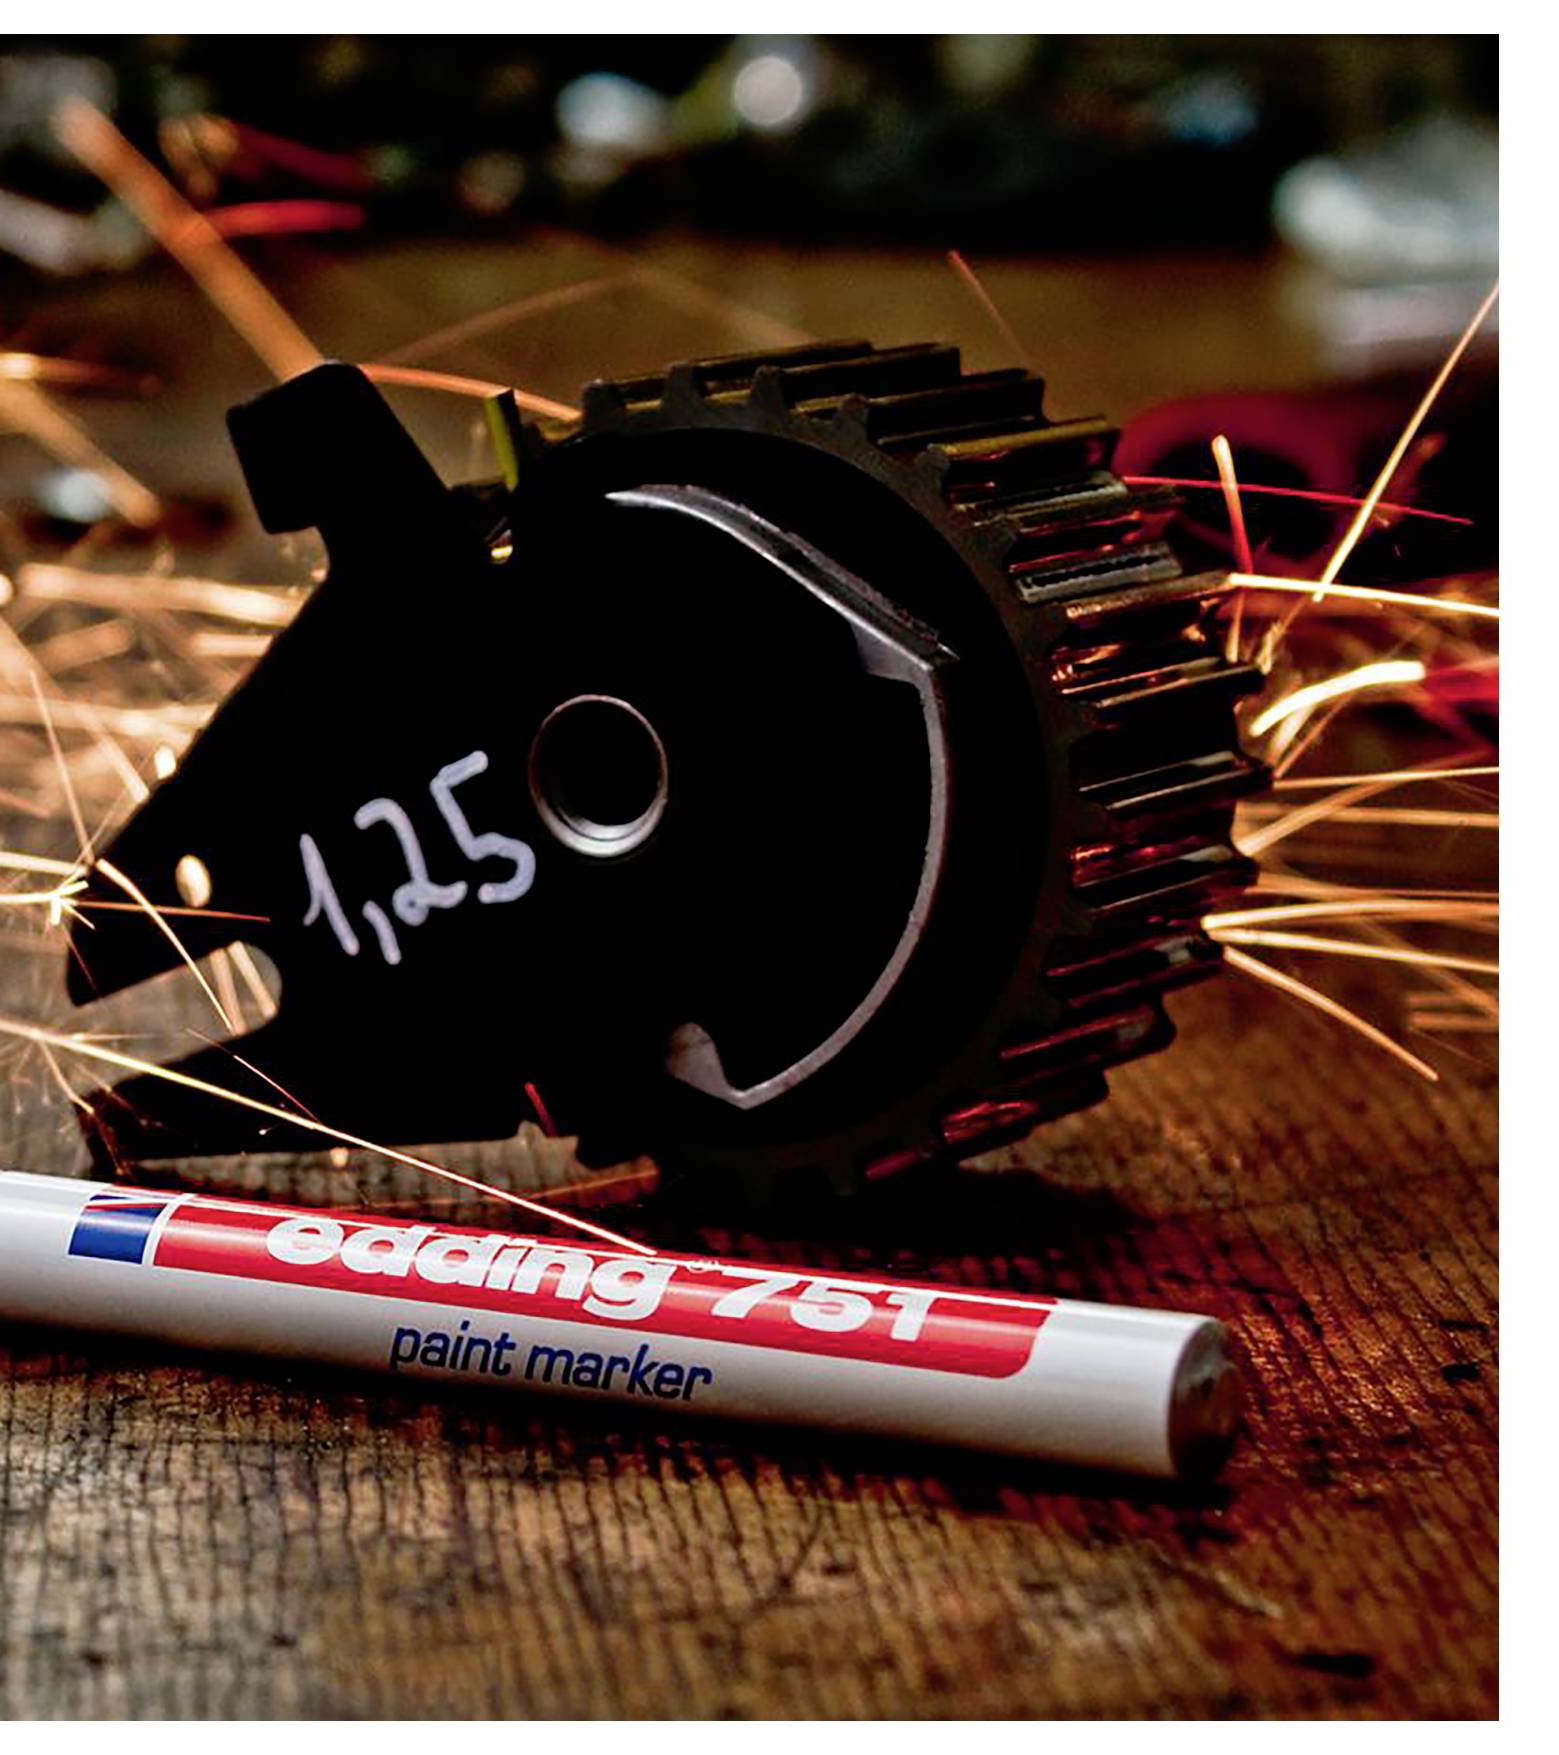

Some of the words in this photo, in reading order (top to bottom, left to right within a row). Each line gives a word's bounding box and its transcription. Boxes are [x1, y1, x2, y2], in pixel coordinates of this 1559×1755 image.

[299, 749, 537, 966] 1,25
[266, 1216, 678, 1321] edding
[711, 1265, 940, 1343] 751
[389, 1321, 517, 1377] paint
[524, 1343, 713, 1401] marker
